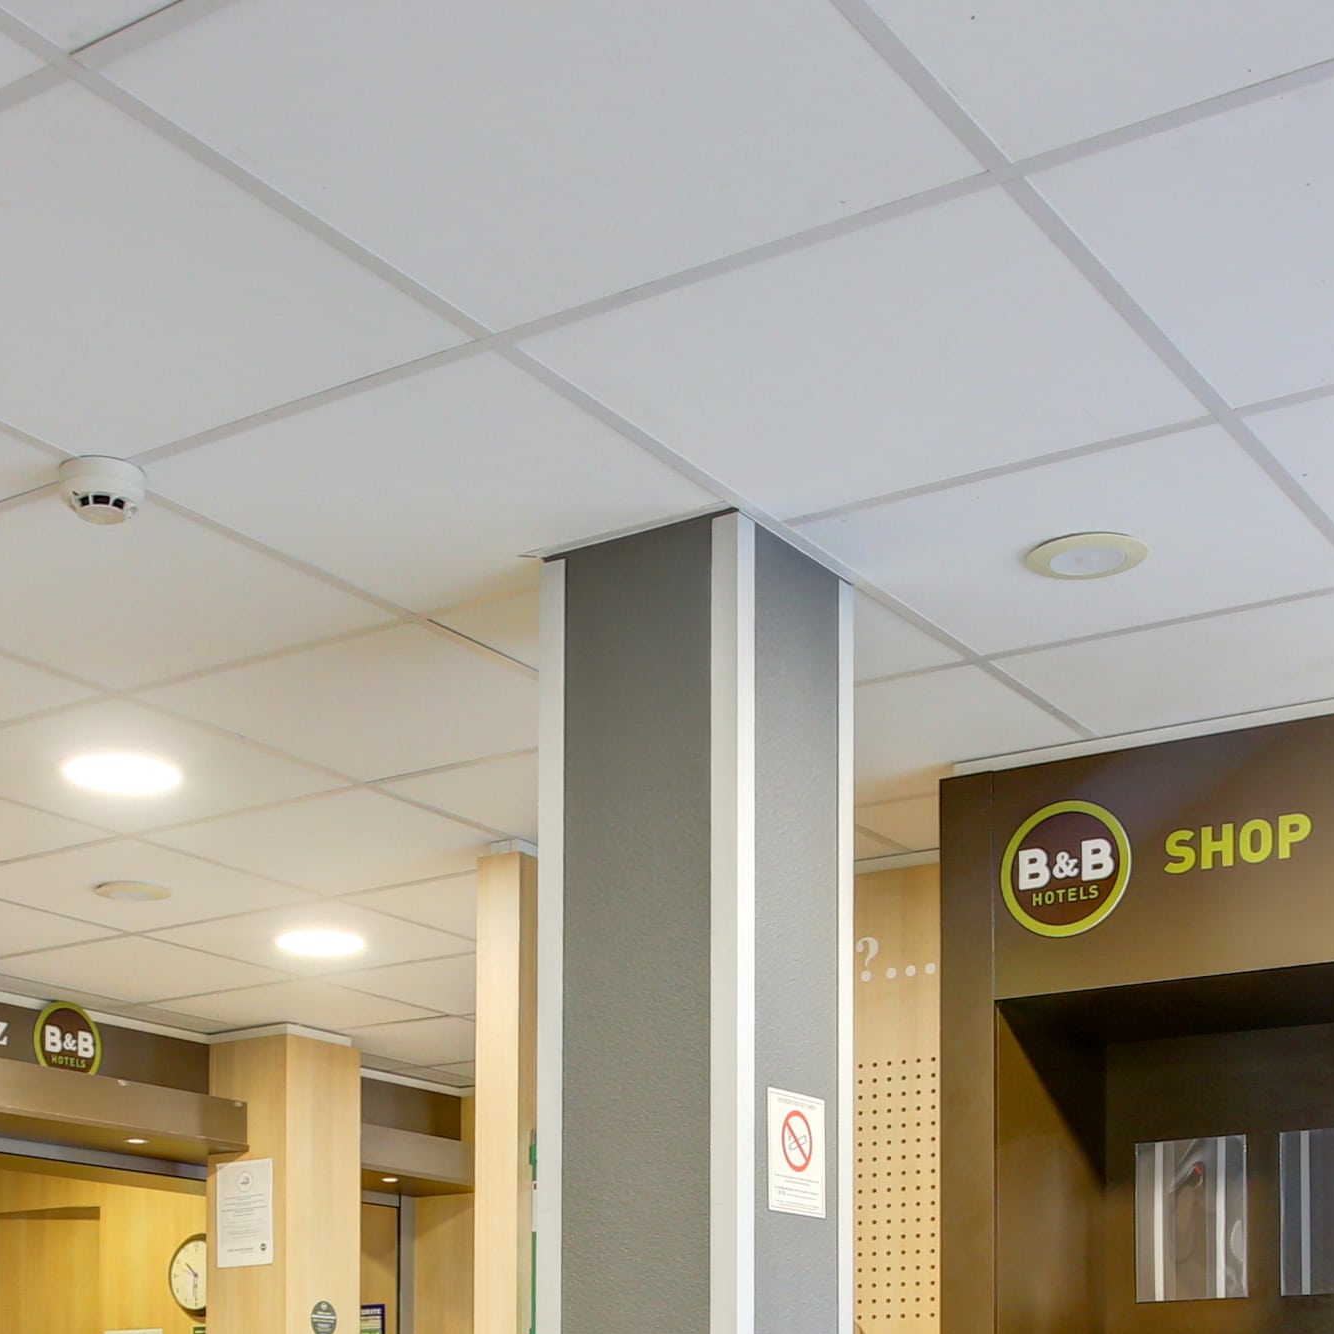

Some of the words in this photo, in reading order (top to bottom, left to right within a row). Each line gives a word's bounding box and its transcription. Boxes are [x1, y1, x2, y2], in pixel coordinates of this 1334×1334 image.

[1164, 813, 1313, 875] SHOP
[1018, 838, 1115, 891] B&B
[1032, 884, 1100, 907] HOTELS
[44, 1024, 96, 1059] B&B
[50, 1054, 87, 1069] HOTELS
